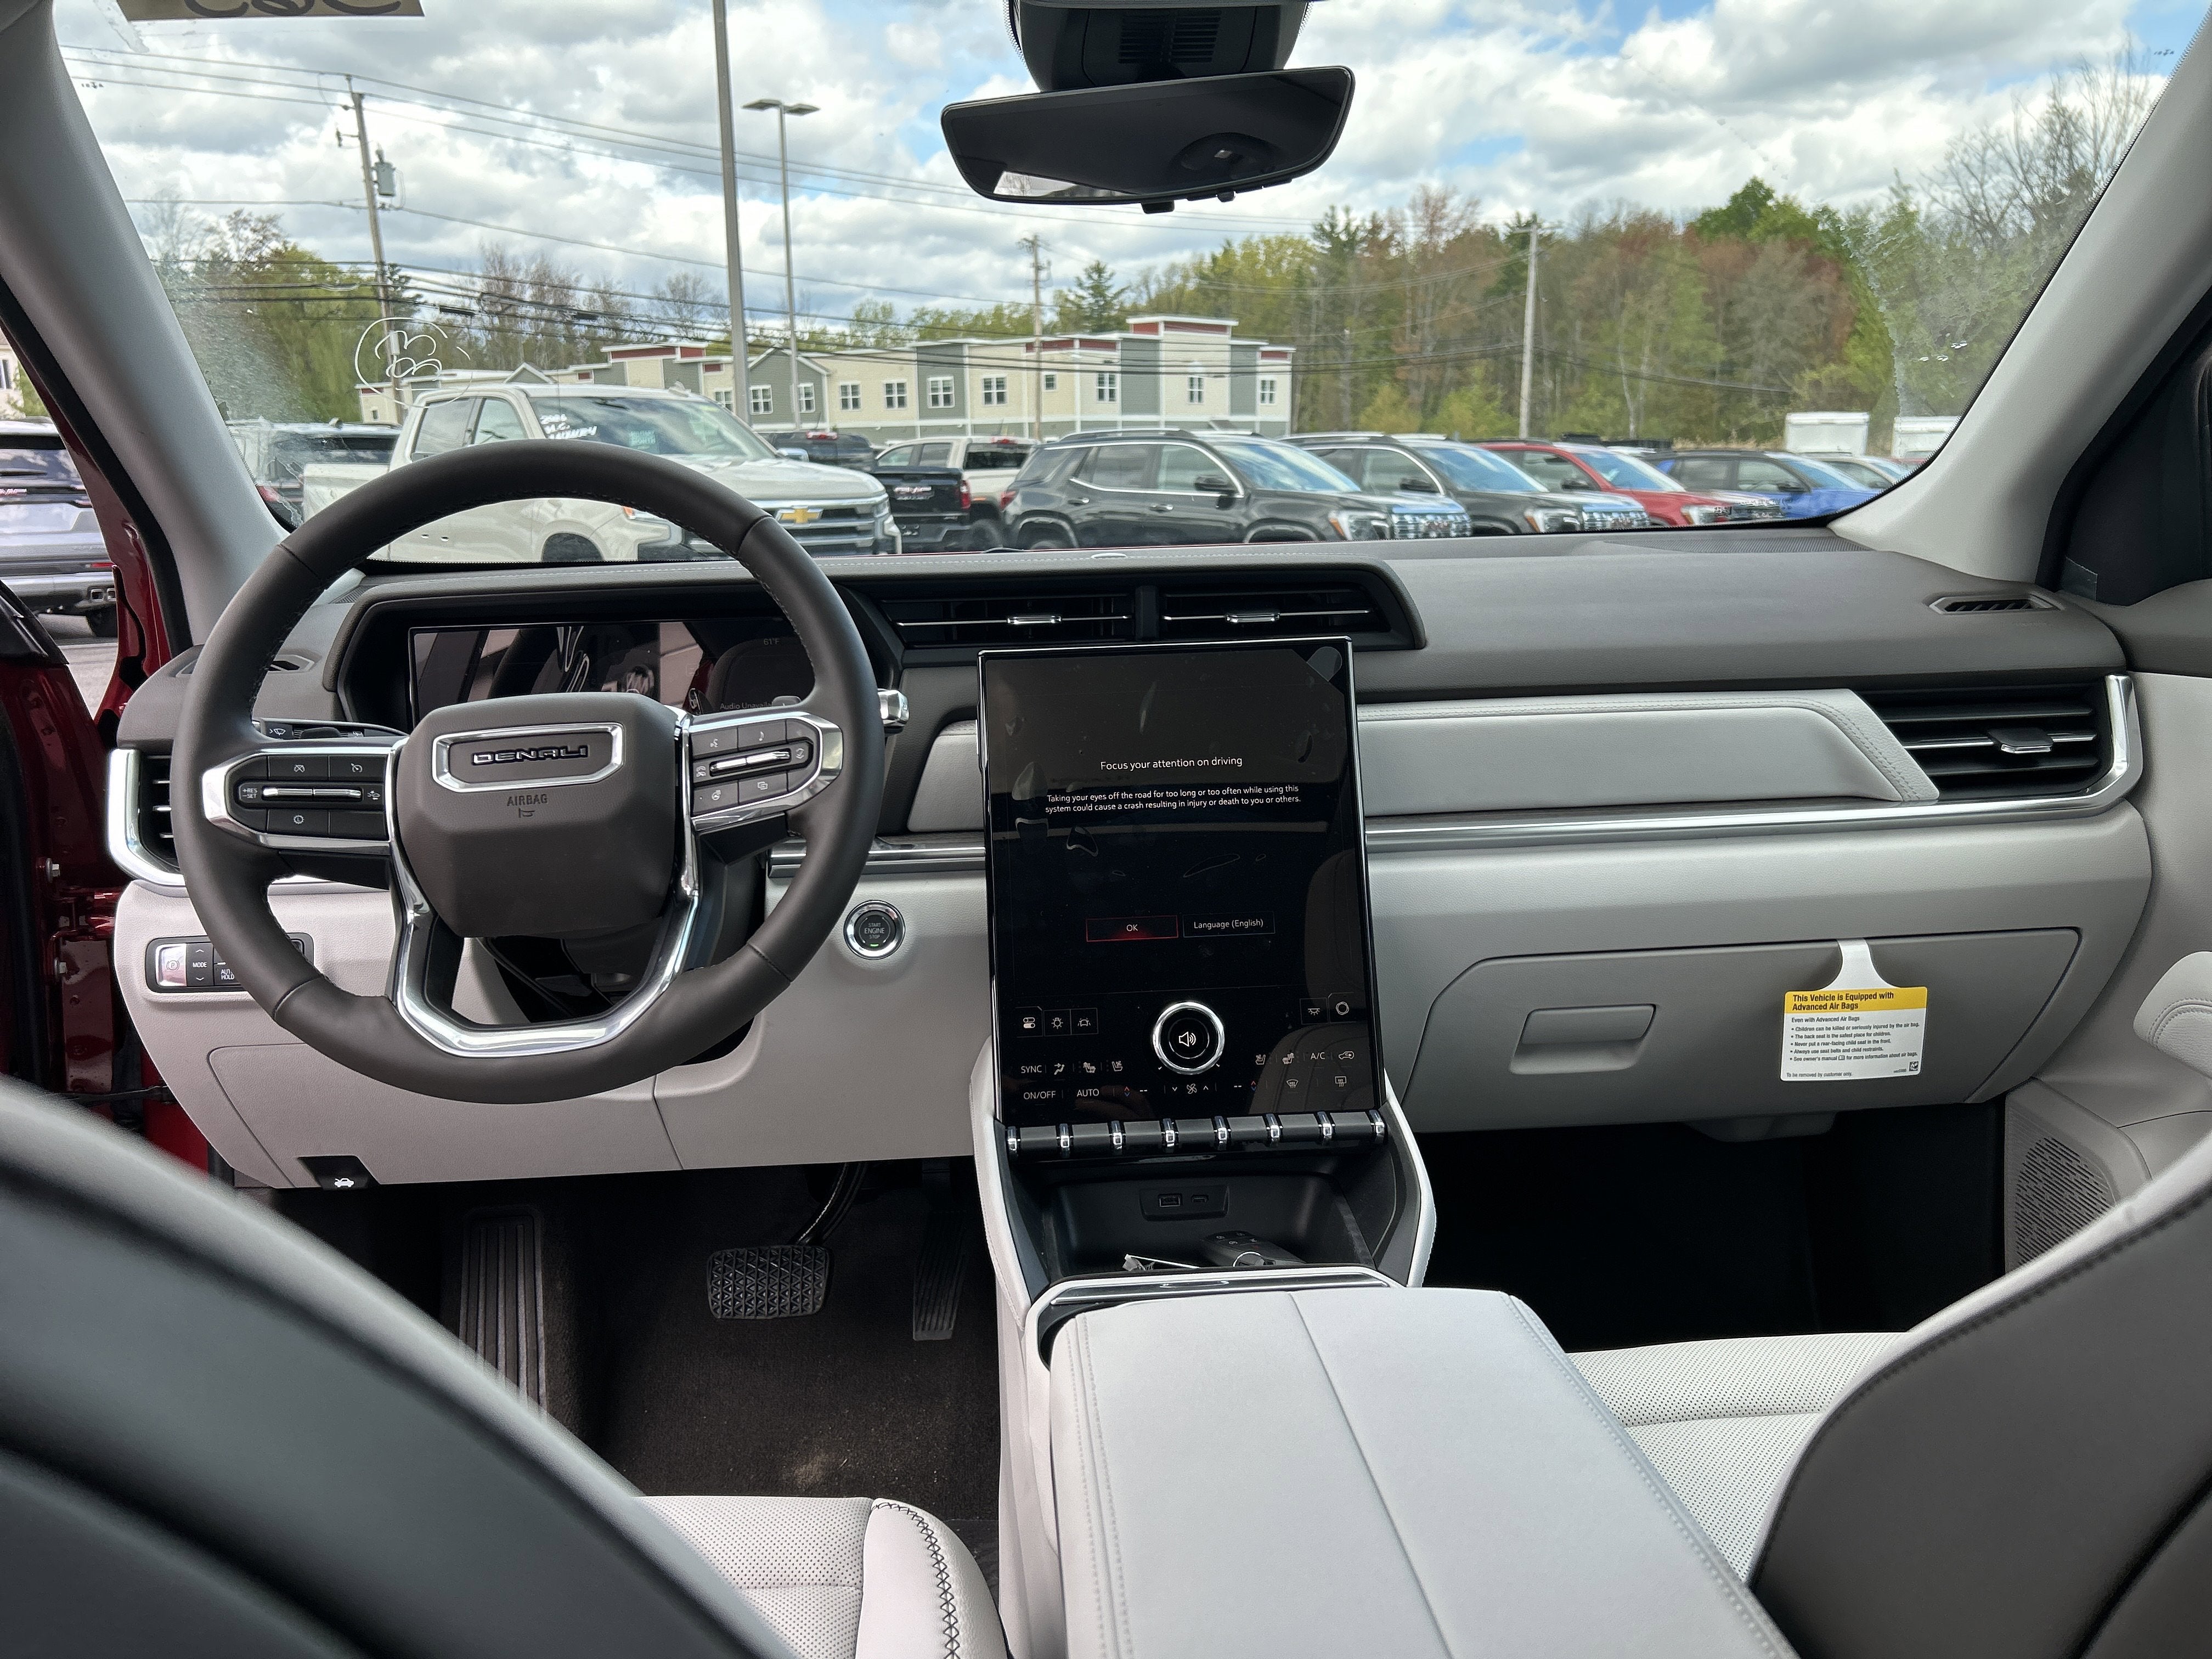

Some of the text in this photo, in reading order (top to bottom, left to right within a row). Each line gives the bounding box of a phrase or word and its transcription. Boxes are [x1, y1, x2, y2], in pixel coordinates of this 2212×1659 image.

[472, 746, 588, 765] DENALI
[1101, 761, 1128, 770] Focus
[1130, 761, 1150, 771] your
[1153, 759, 1195, 768] attention
[1211, 757, 1243, 767] driving
[507, 794, 548, 806] AIRBAG
[1047, 794, 1070, 803] Taking
[1180, 789, 1195, 798] long
[1146, 800, 1177, 809] resulting
[1187, 800, 1207, 808] injury
[1194, 919, 1263, 930] Language (English)
[1846, 992, 1877, 1001] Equipped
[1792, 1002, 1827, 1011] Advanced
[1841, 1002, 1859, 1011] Bags
[1020, 1065, 1042, 1074] SYNC
[1024, 1091, 1056, 1099] ON/OFF
